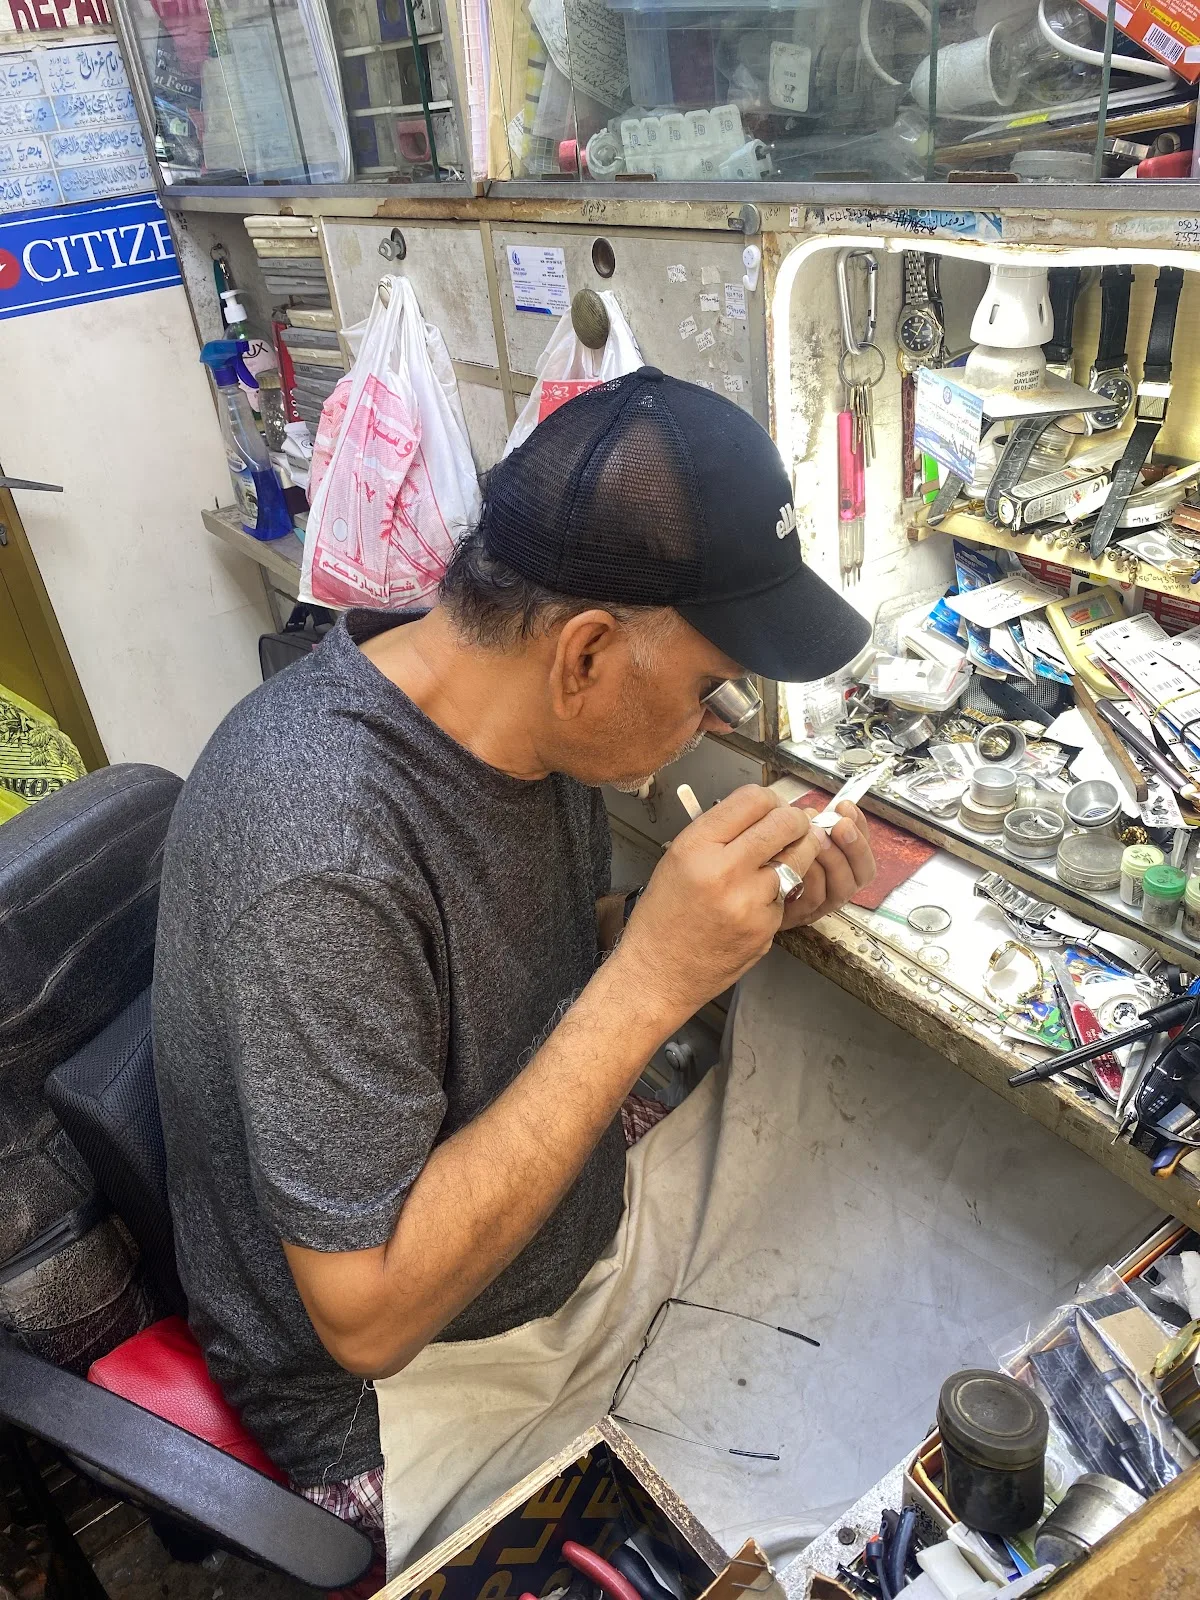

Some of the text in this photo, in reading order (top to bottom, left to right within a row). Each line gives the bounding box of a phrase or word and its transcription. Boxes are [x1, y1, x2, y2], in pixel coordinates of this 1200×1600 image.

[166, 74, 194, 93] Fear
[22, 219, 176, 283] CITIZE
[1013, 375, 1040, 385] DAYLIGHT
